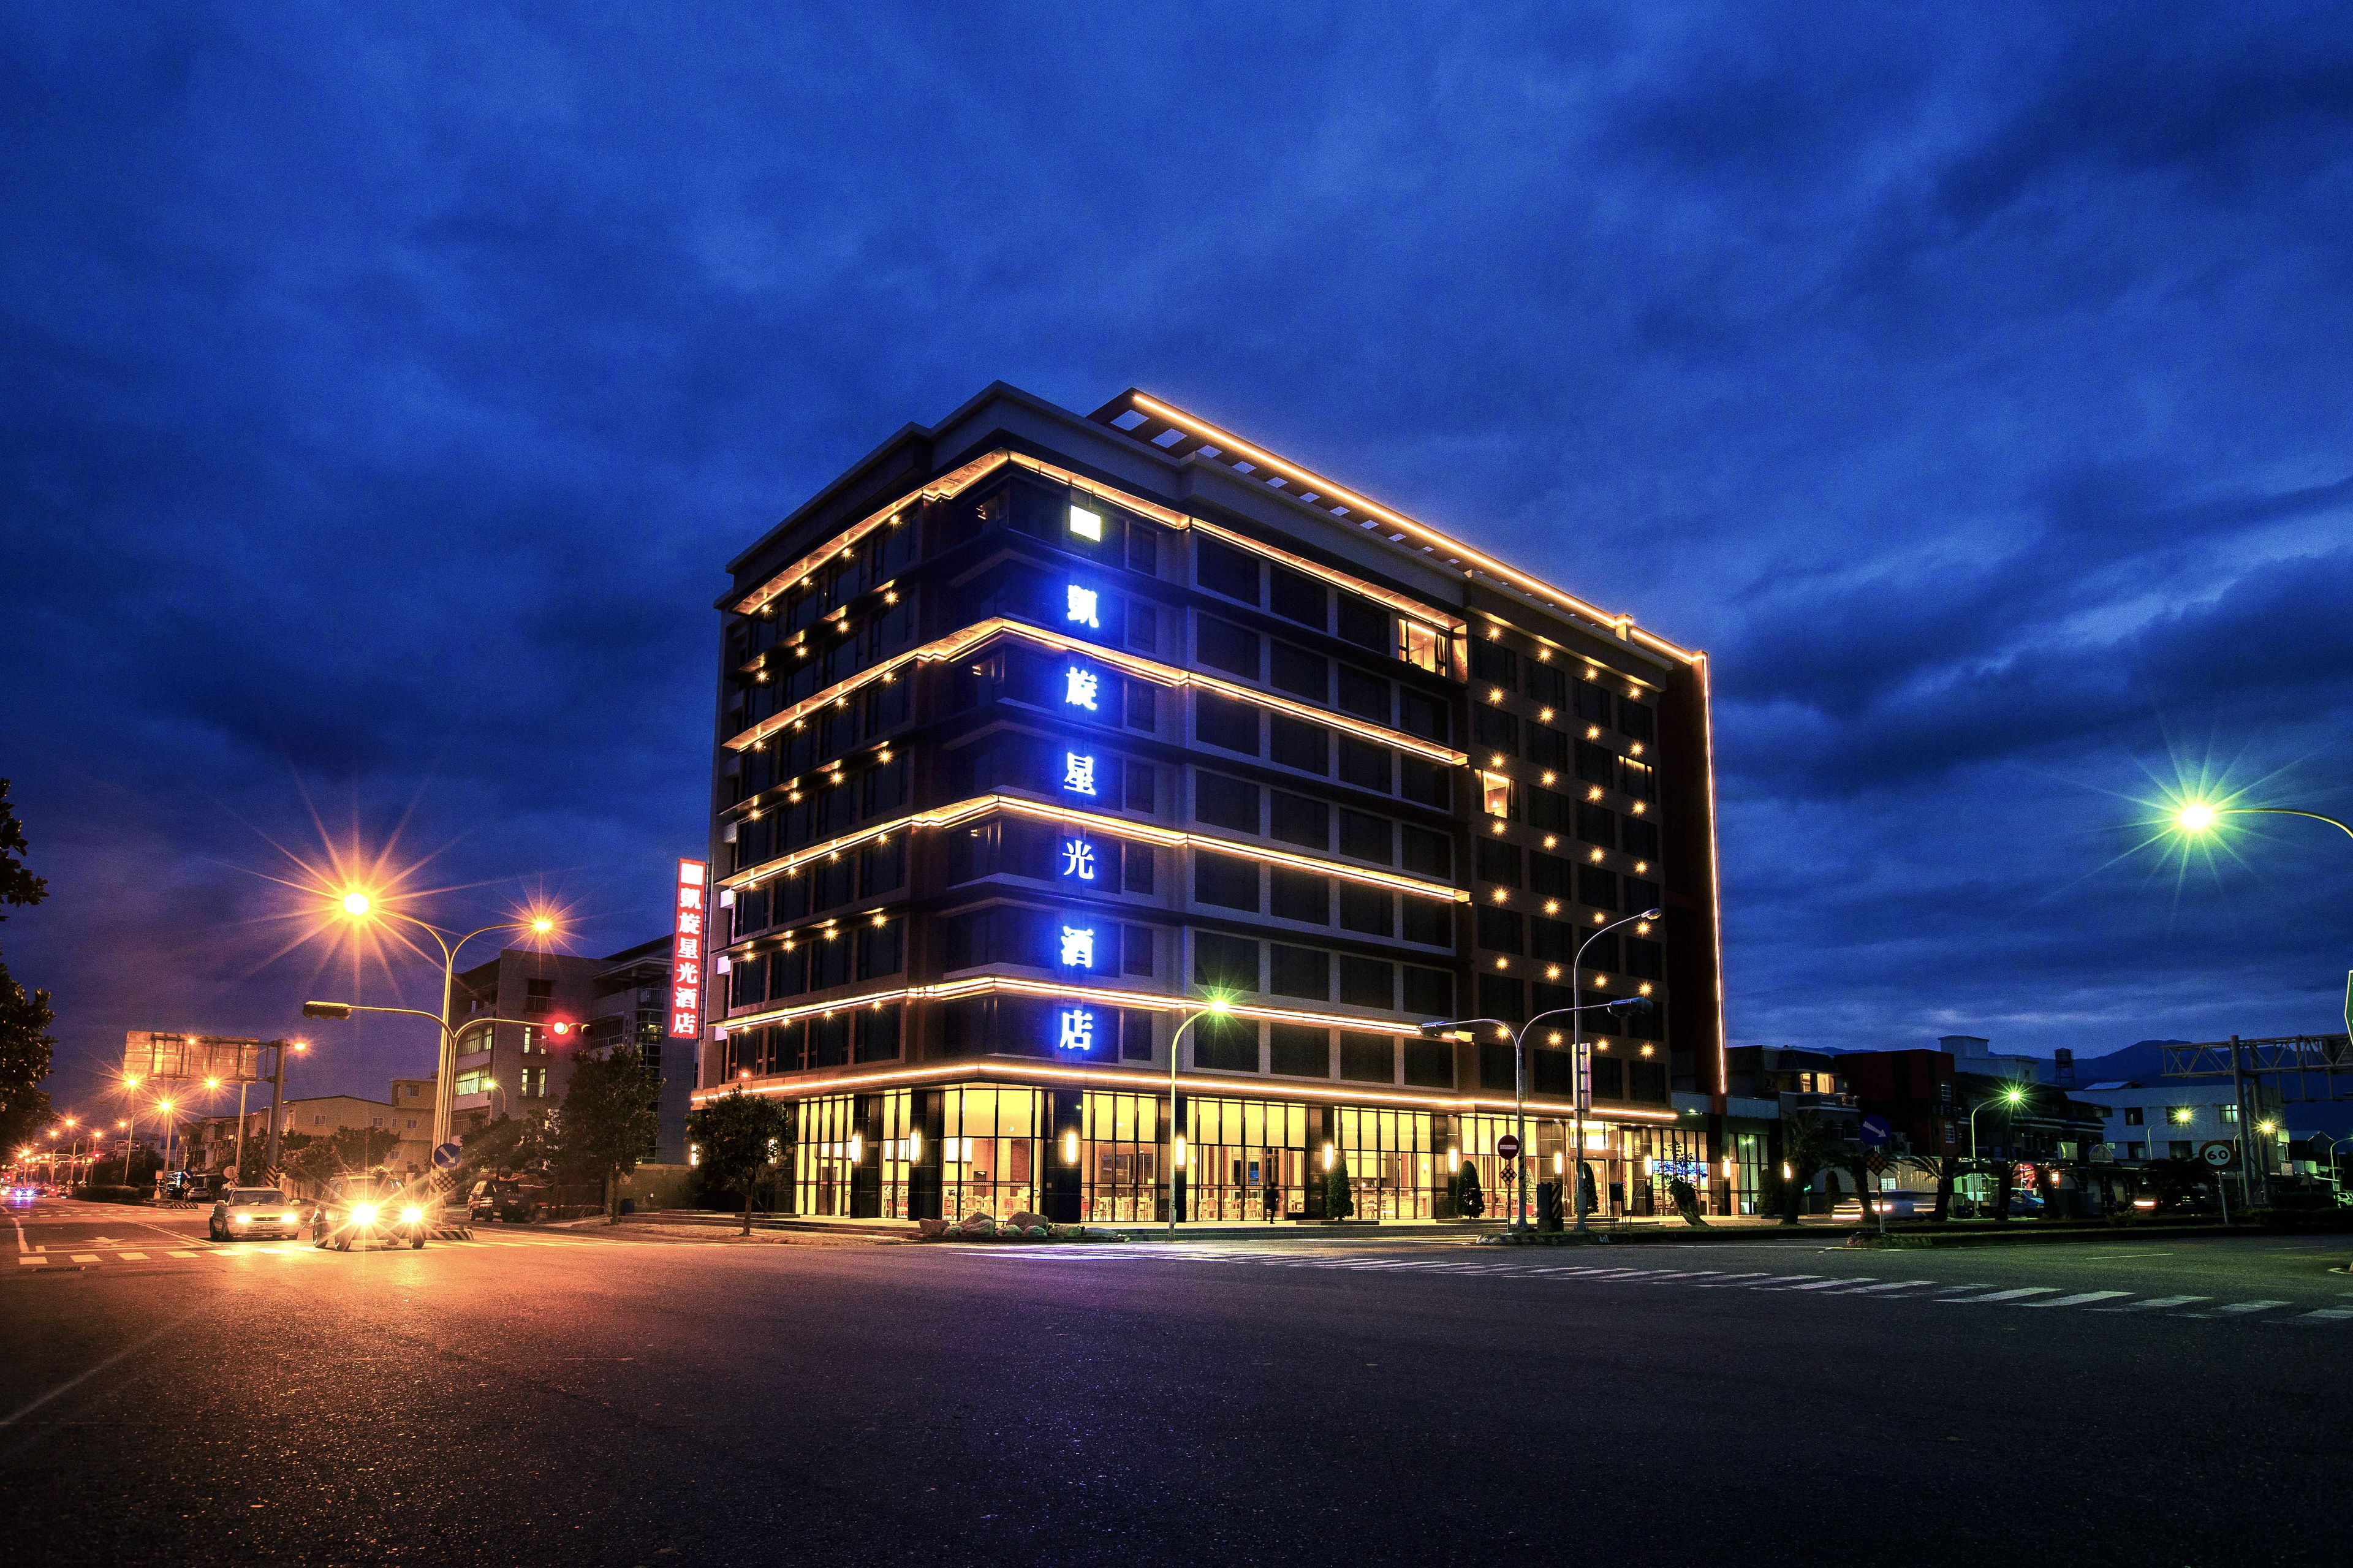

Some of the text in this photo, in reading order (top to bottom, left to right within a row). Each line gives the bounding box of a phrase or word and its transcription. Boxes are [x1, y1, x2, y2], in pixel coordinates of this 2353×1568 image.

[1060, 585, 1099, 1051] 凱旋星光酒店
[673, 887, 702, 1034] 凱旋星光酒店
[2207, 1150, 2228, 1160] 60
